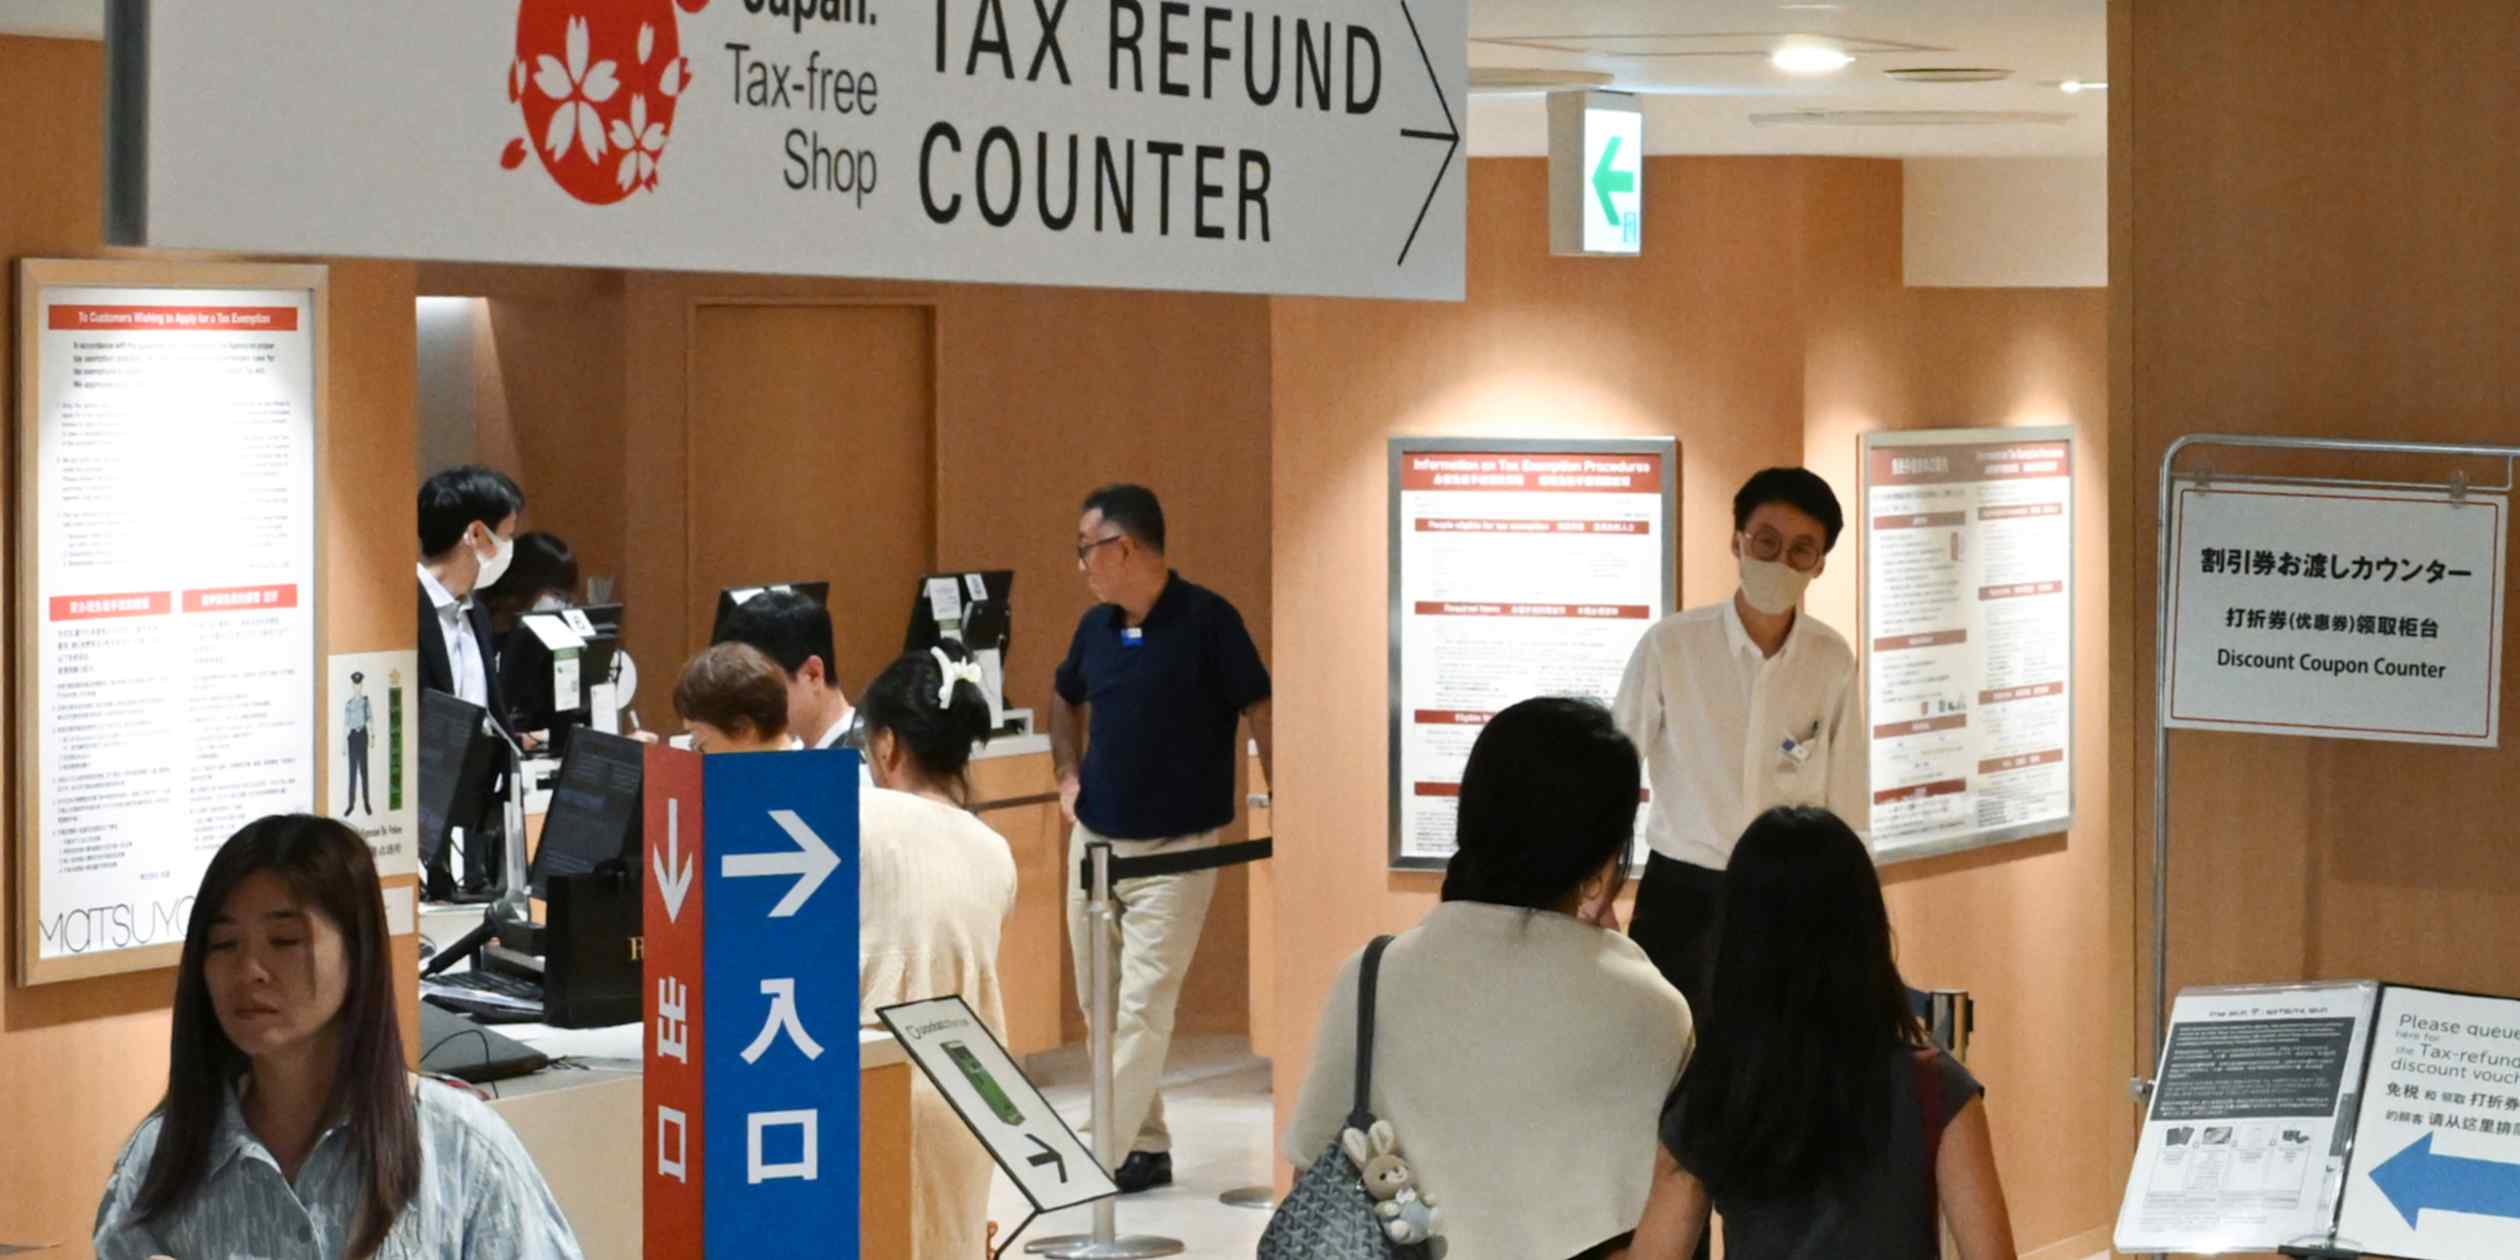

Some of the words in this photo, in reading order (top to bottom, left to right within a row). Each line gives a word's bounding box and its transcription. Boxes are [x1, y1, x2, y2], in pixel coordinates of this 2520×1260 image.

[1109, 0, 1381, 114] REFUND
[725, 42, 877, 116] Tax-free
[784, 128, 877, 209] Shop
[919, 121, 1271, 242] COUNTER
[1413, 459, 1479, 471] Information
[1522, 459, 1581, 472] Exemption
[1584, 460, 1650, 472] Procedures
[2200, 548, 2472, 584] 割引券お渡しカウンター
[2226, 607, 2439, 638] 打折券(优惠券)领取柜台
[2217, 648, 2295, 670] Discount
[2299, 653, 2368, 676] Coupon
[2374, 657, 2446, 678] Counter
[2400, 1013, 2461, 1034] Please
[657, 976, 688, 1183] 出口
[740, 978, 825, 1184] 入口
[2391, 1058, 2467, 1079] discount
[2385, 1081, 2419, 1100] 免税
